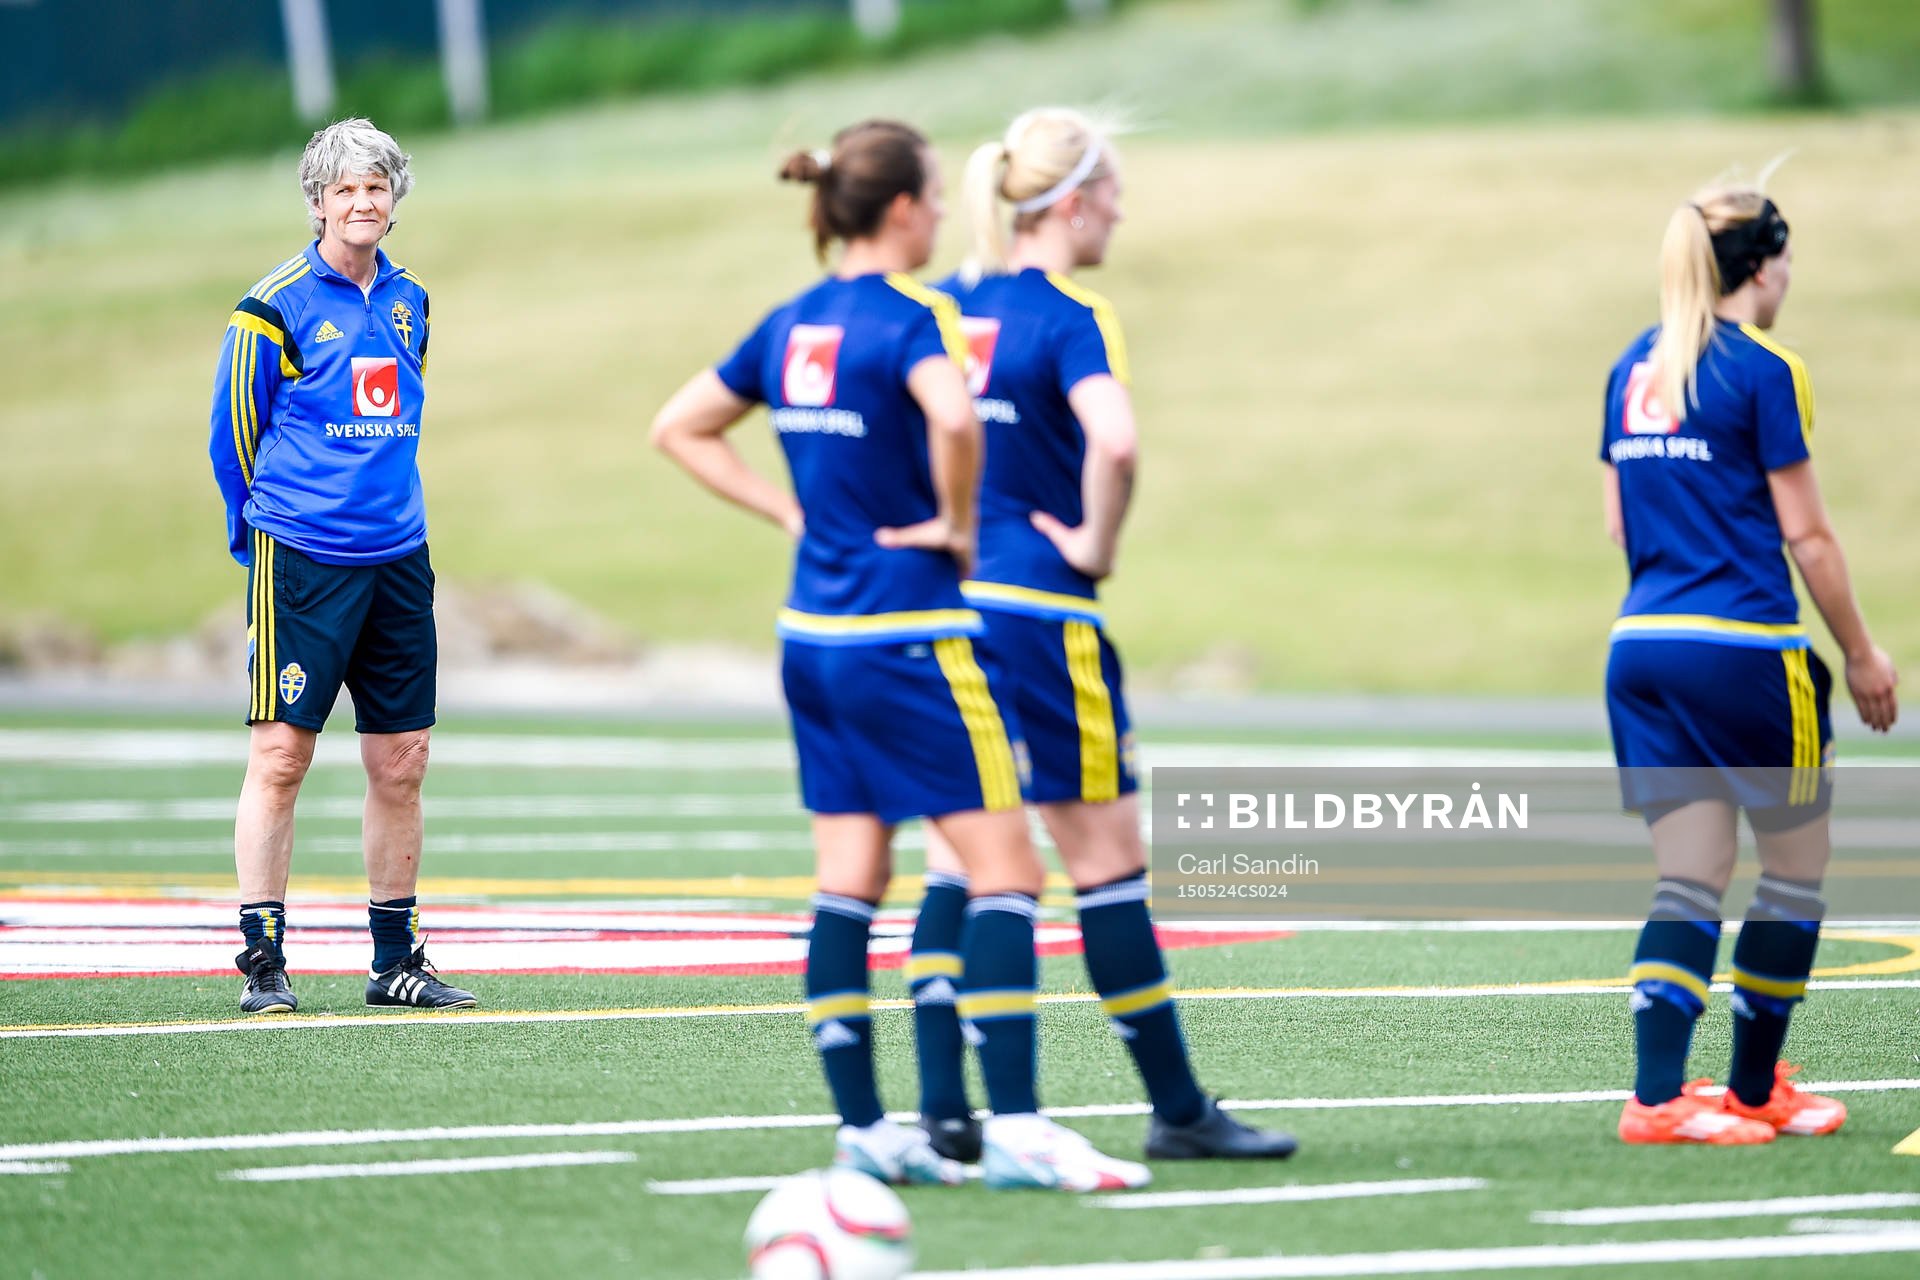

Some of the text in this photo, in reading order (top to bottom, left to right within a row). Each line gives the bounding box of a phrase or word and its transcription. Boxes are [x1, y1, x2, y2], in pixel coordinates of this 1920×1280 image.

[314, 330, 344, 343] adidas
[325, 422, 418, 438] SVENSKA SPEL
